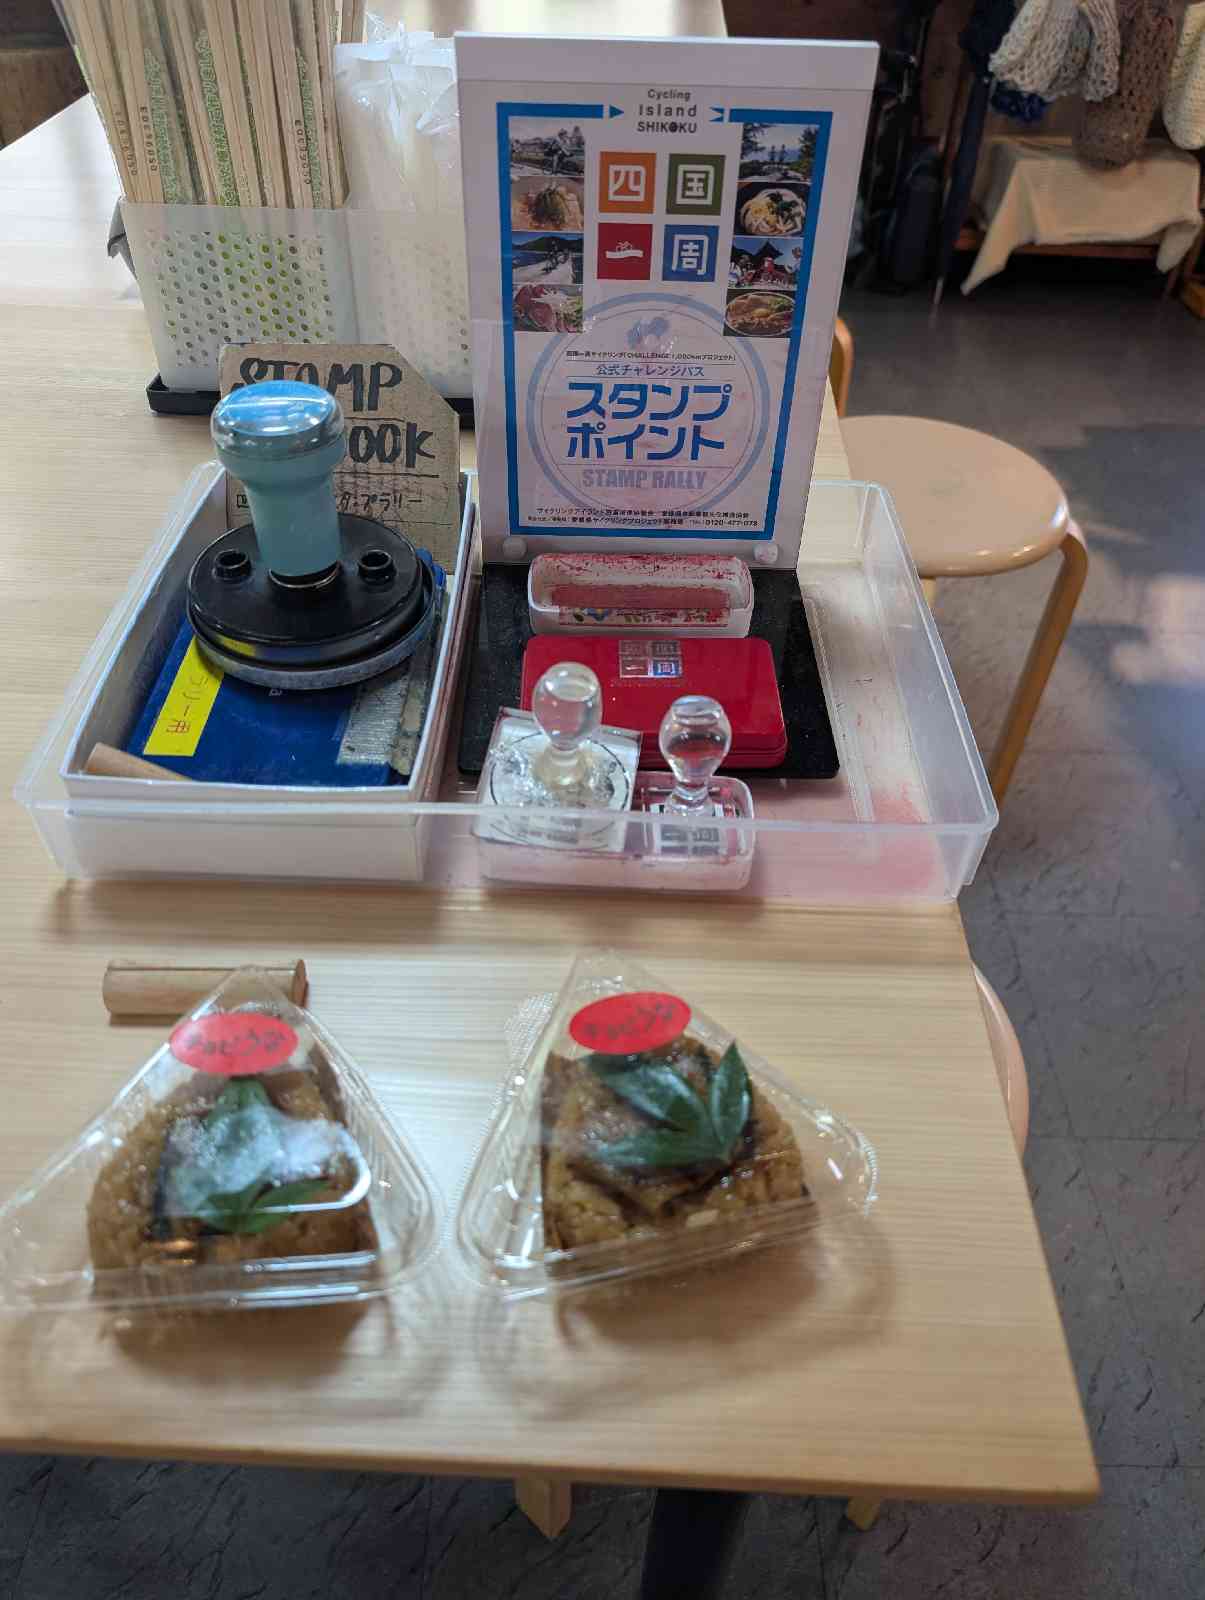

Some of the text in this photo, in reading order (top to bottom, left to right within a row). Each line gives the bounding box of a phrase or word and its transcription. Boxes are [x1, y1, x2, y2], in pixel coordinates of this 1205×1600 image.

[647, 88, 691, 102] Cycling
[639, 103, 697, 117] Island
[637, 121, 697, 134] SHIKOKU
[566, 382, 733, 422] スタンプ
[566, 422, 725, 460] ポイント
[582, 469, 706, 489] STAMP RALLY
